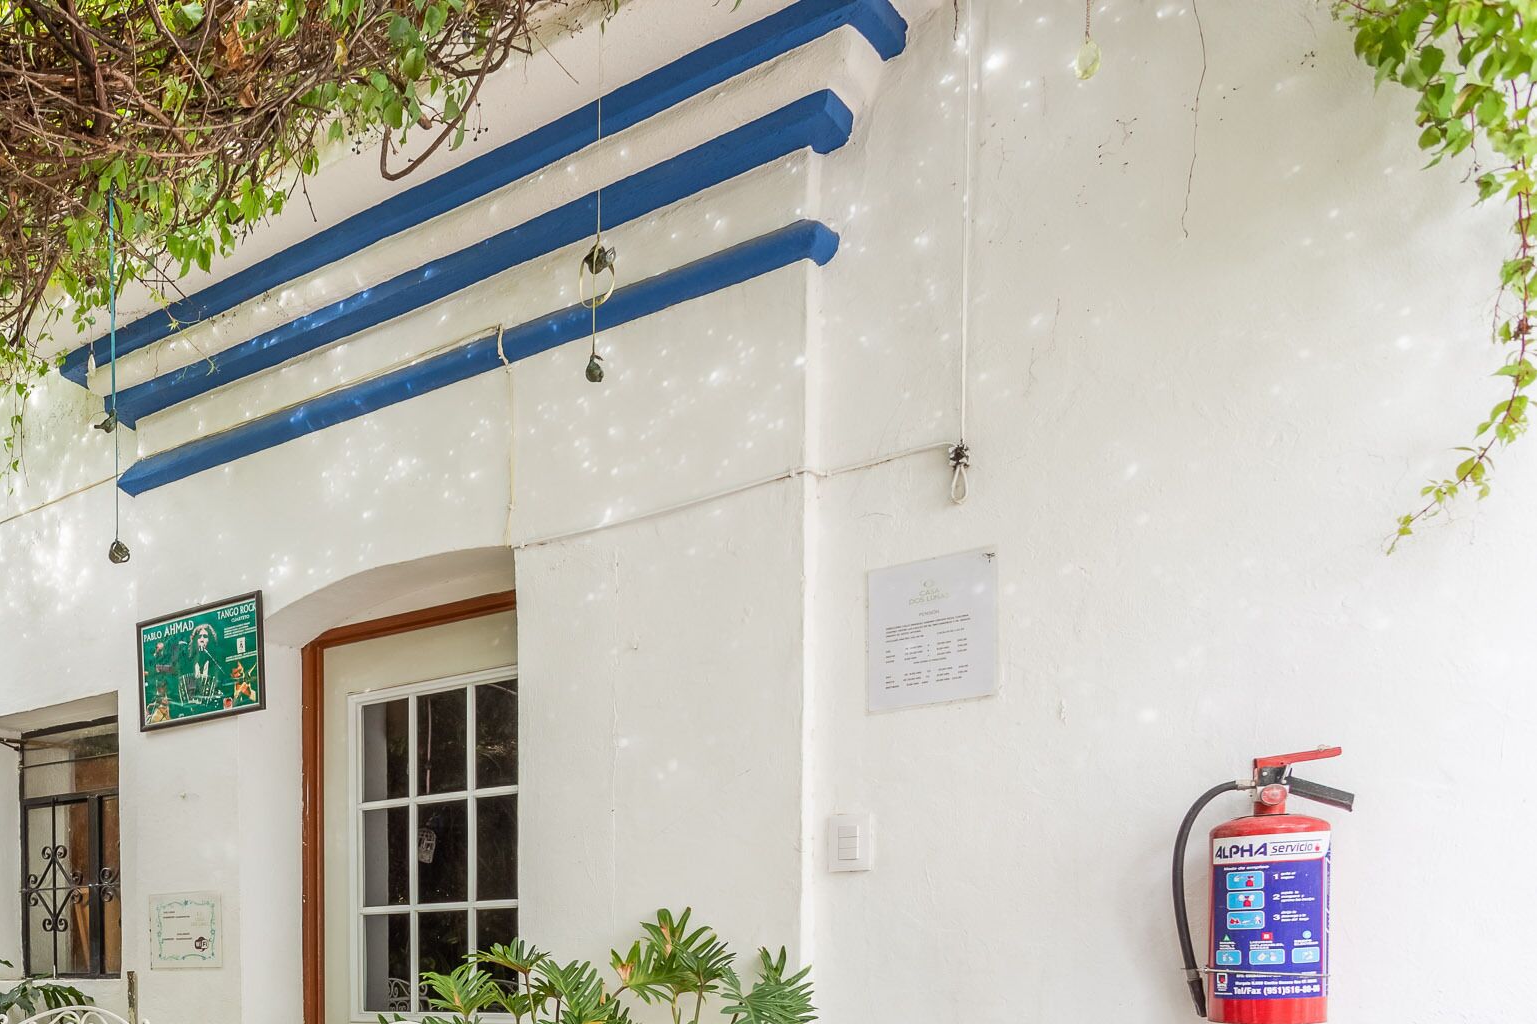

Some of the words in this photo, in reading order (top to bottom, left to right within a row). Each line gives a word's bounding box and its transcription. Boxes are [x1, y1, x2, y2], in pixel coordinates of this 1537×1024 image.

[216, 606, 239, 620] TANGO
[143, 630, 163, 643] PABLO
[164, 620, 194, 638] AHMAD
[1215, 842, 1268, 860] ALPHA
[1272, 842, 1313, 853] servicio
[1272, 893, 1281, 901] 2
[1233, 985, 1262, 995] Tel/Fax
